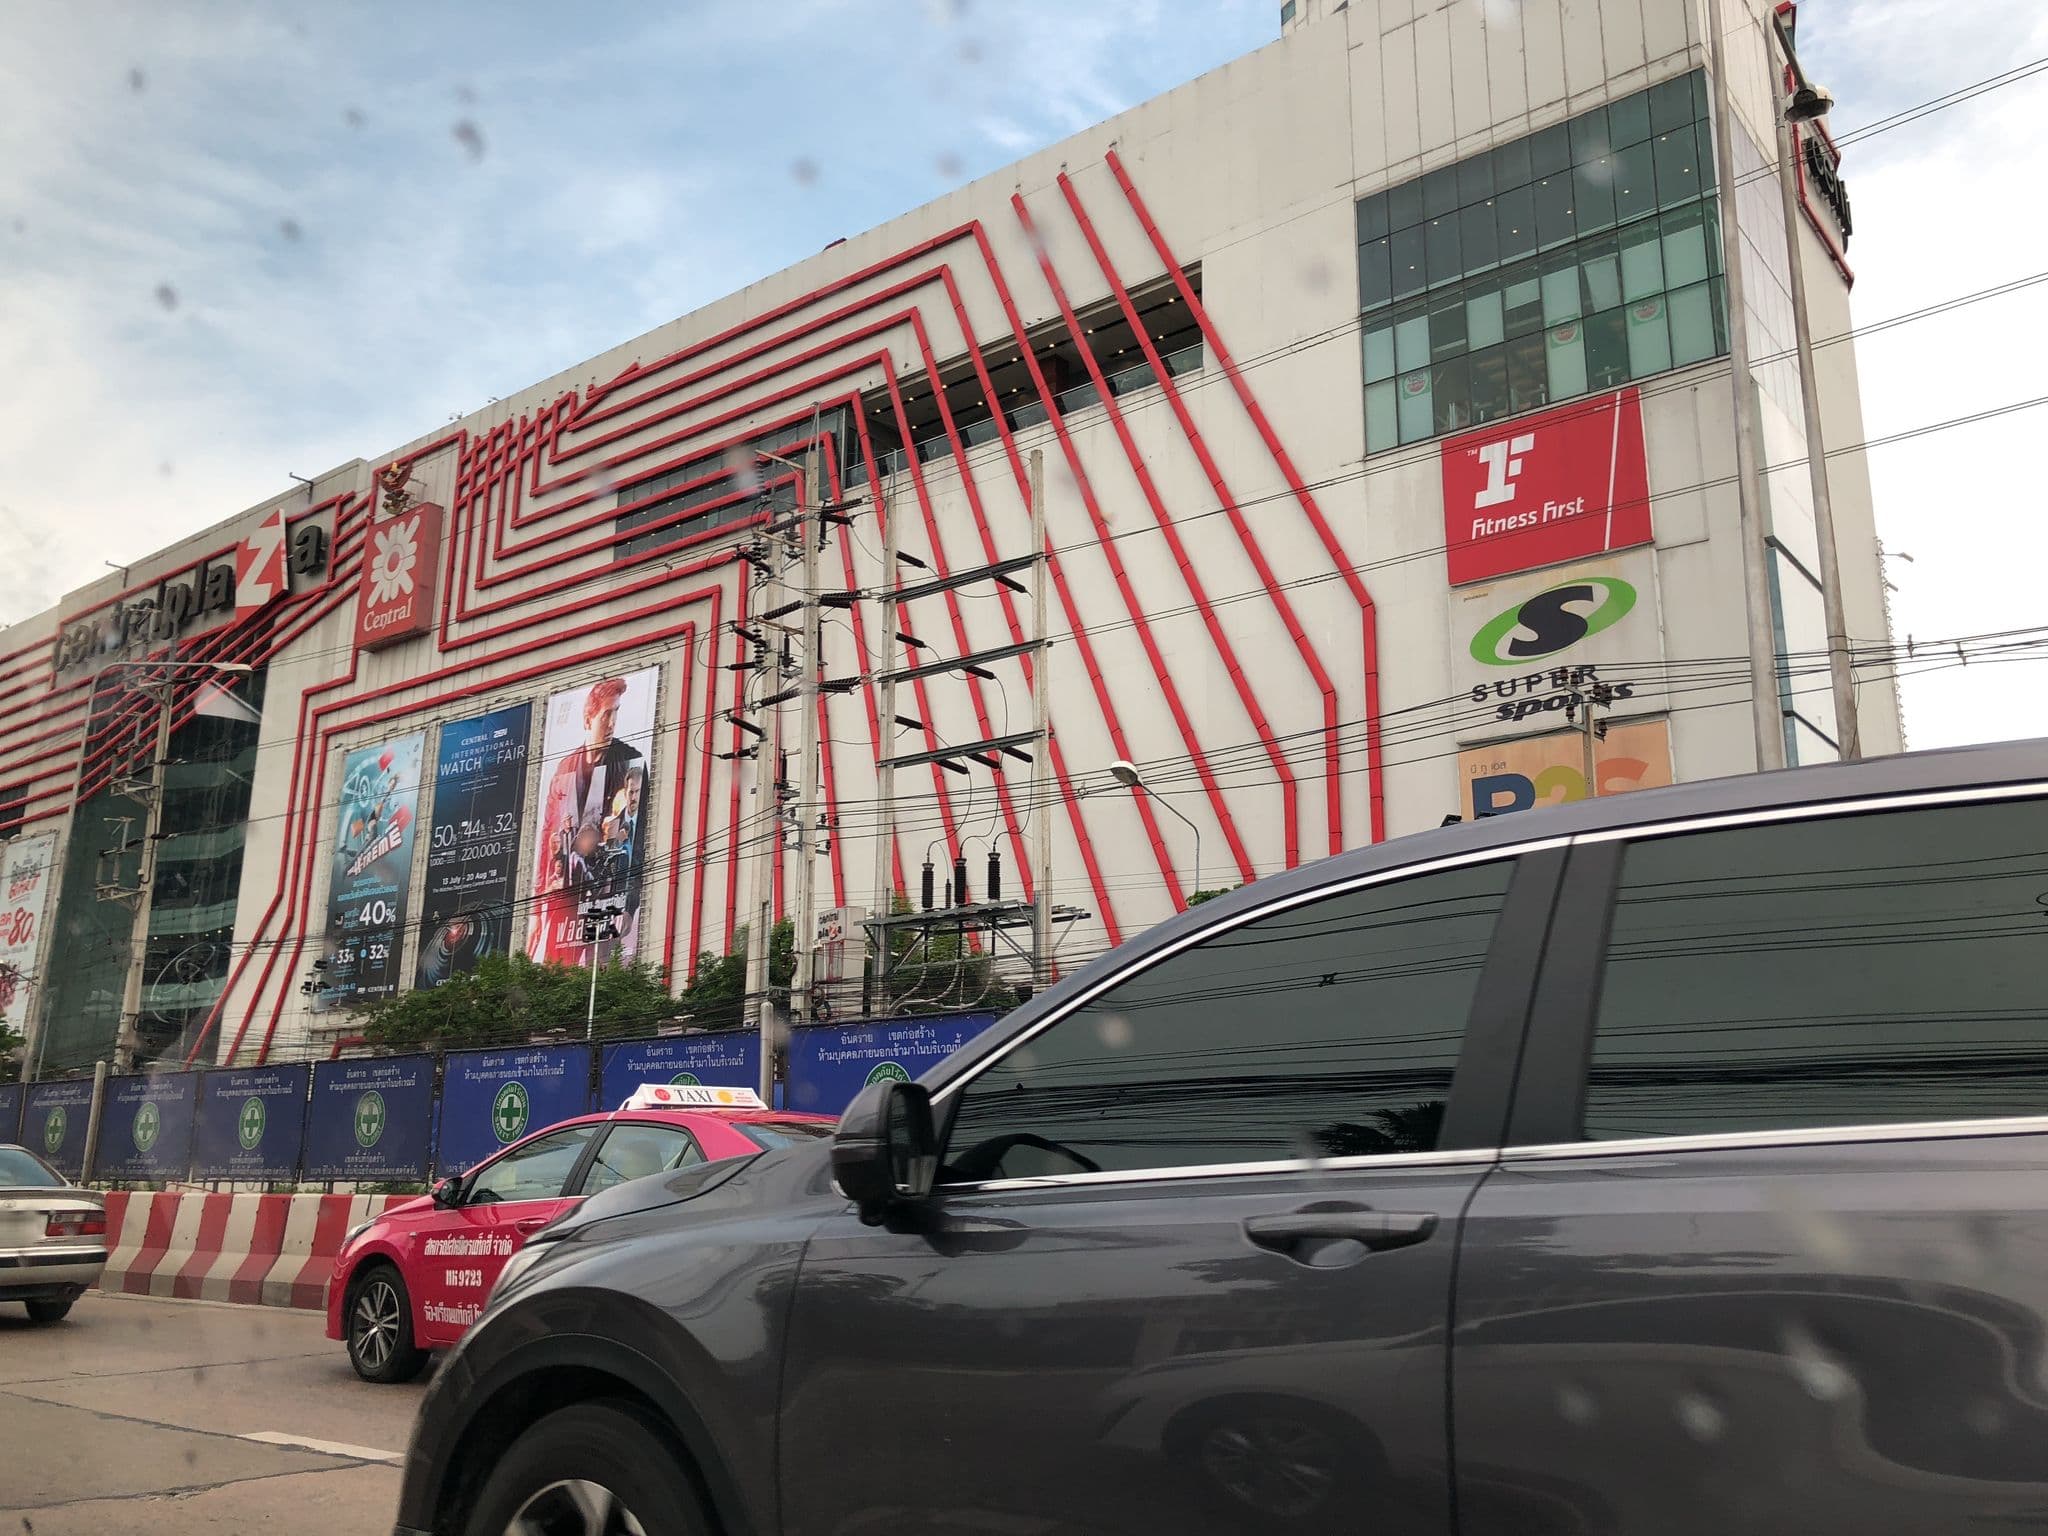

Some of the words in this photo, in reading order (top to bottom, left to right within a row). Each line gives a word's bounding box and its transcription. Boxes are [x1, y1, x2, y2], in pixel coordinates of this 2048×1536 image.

[1471, 510, 1538, 540] Fitness
[1542, 496, 1585, 524] First
[363, 596, 414, 632] Central
[1471, 665, 1600, 702] SUPER
[440, 756, 482, 776] WATCH
[496, 745, 526, 764] FAIR
[451, 739, 515, 760] INTERNATIONAL
[841, 1031, 873, 1044] อันตราย
[888, 1024, 935, 1041] เขตก่อสร้าง
[514, 1052, 547, 1065] เขตก่อสร้าง
[646, 1045, 673, 1057] อันตราย
[685, 1041, 724, 1055] เขตก่อสร้าง
[627, 1048, 745, 1074] ห้ามบุคคลภายนอกเข้ามาในบริเวณนี้
[673, 1089, 713, 1103] TAXI
